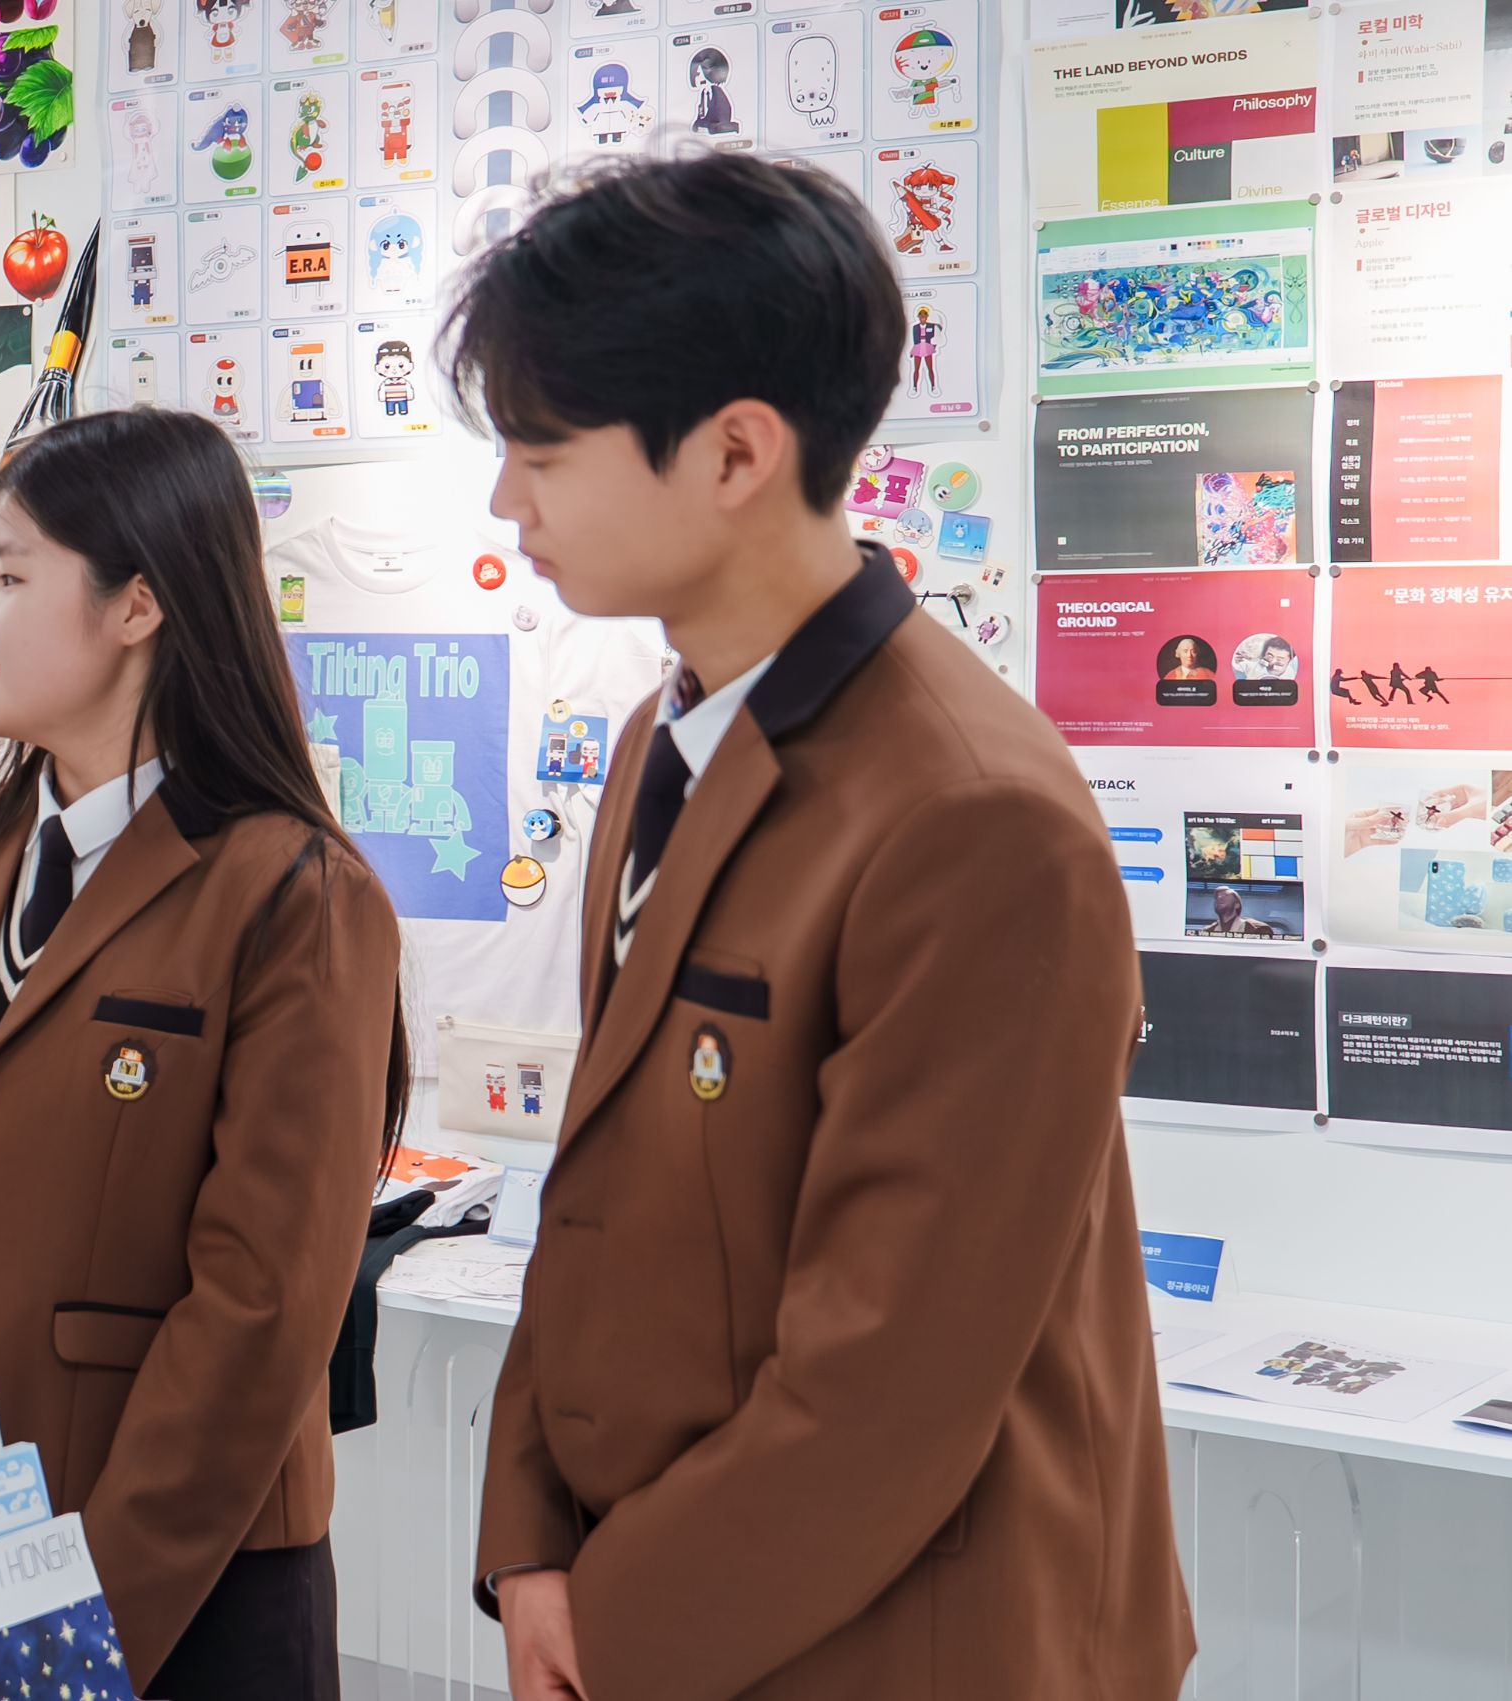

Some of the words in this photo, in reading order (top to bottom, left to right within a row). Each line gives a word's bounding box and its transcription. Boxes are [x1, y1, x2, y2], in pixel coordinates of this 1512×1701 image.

[1357, 18, 1388, 35] 로컬
[1392, 13, 1424, 32] 미학
[1357, 39, 1463, 60] 와비사비(Wabi-Sabi)
[1053, 67, 1082, 80] THE
[1086, 62, 1125, 77] LAND
[1128, 55, 1188, 72] BEYOND
[1191, 49, 1248, 66] WORDS
[1232, 92, 1313, 112] Philosophy
[1174, 147, 1226, 163] Culture
[1237, 183, 1283, 199] Divine
[1101, 197, 1160, 212] Essence
[1355, 205, 1401, 224] 글로벌
[1405, 201, 1451, 219] 디자인
[1354, 238, 1385, 249] Apple
[289, 256, 327, 274] E.R.A
[1376, 380, 1404, 389] Global
[1057, 428, 1104, 441] FROM
[1106, 422, 1210, 440] PERFECTION,
[1057, 444, 1079, 457] TO
[1082, 439, 1199, 456] PARTICIPATION
[1429, 586, 1479, 604] 정체성
[1056, 601, 1155, 614] THEOLOGICAL
[1056, 616, 1117, 628] GROUND
[306, 641, 407, 700] Tilting
[414, 642, 480, 699] Trio
[1085, 779, 1136, 791] WBACK
[1210, 930, 1226, 938] need
[1342, 1013, 1408, 1026] 다크패턴이란?
[1166, 1279, 1211, 1295] 정규동아리
[6, 1527, 82, 1585] HONGIK
